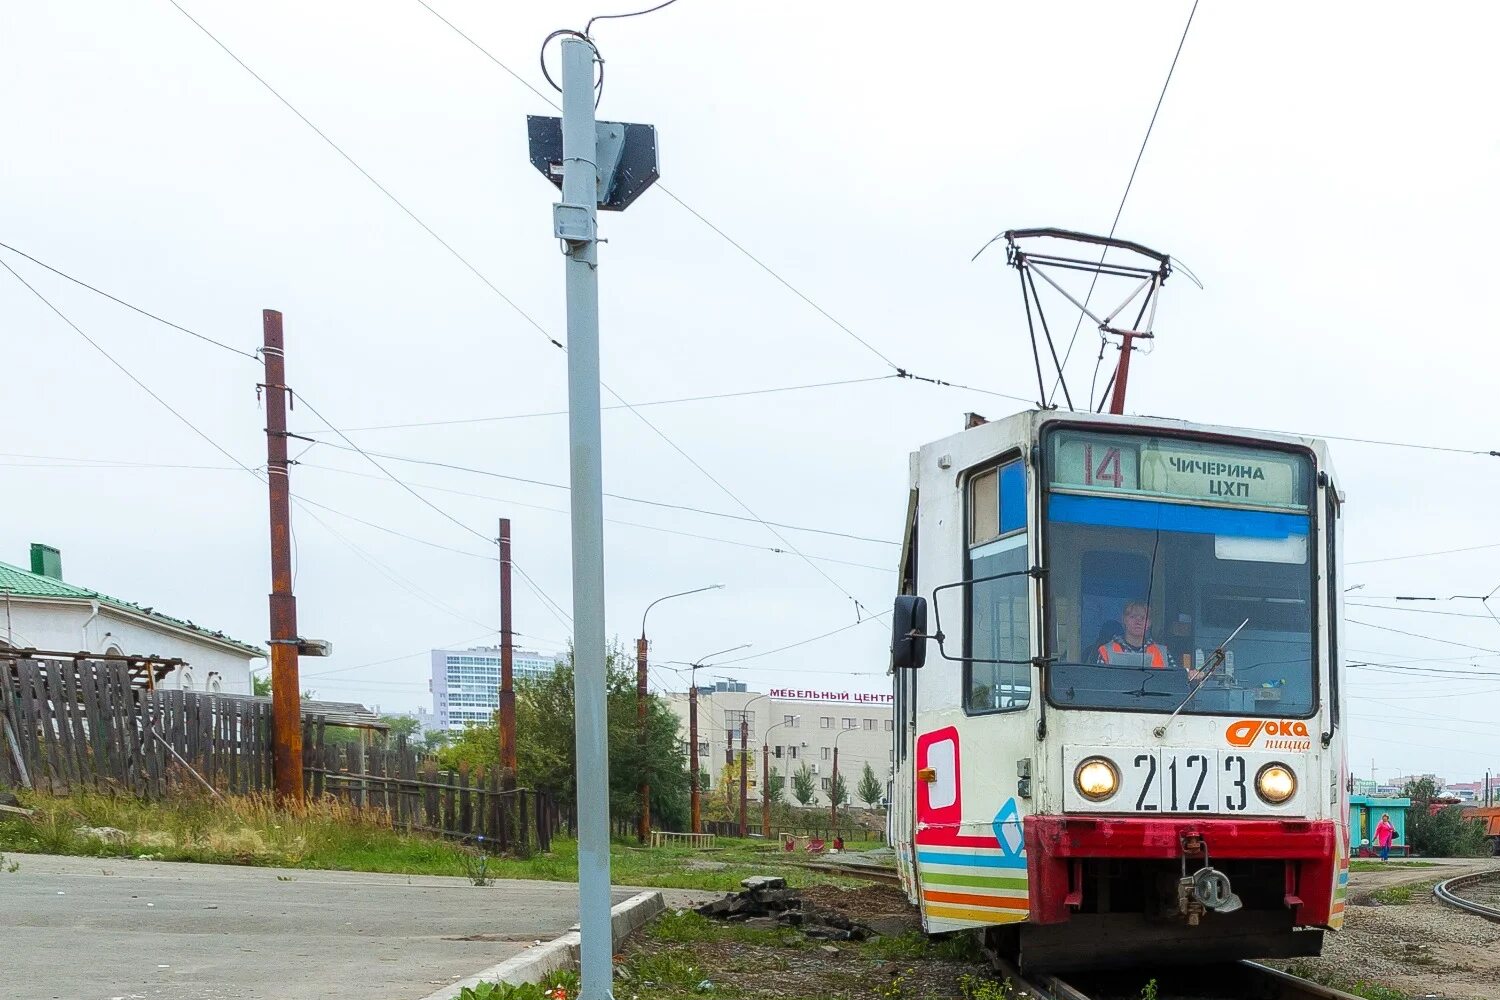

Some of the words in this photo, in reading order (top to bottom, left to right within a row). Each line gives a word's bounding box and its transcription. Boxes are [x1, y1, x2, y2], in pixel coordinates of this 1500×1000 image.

[1083, 443, 1124, 488] 14
[1169, 457, 1265, 480] ЧИЧЕРИНА
[1209, 480, 1249, 497] ЦХП
[769, 689, 849, 700] МЕБЕЛЬНЫЙ
[854, 693, 894, 703] ЦЕНТР
[1264, 739, 1311, 752] пицца
[1134, 755, 1247, 811] 2123
